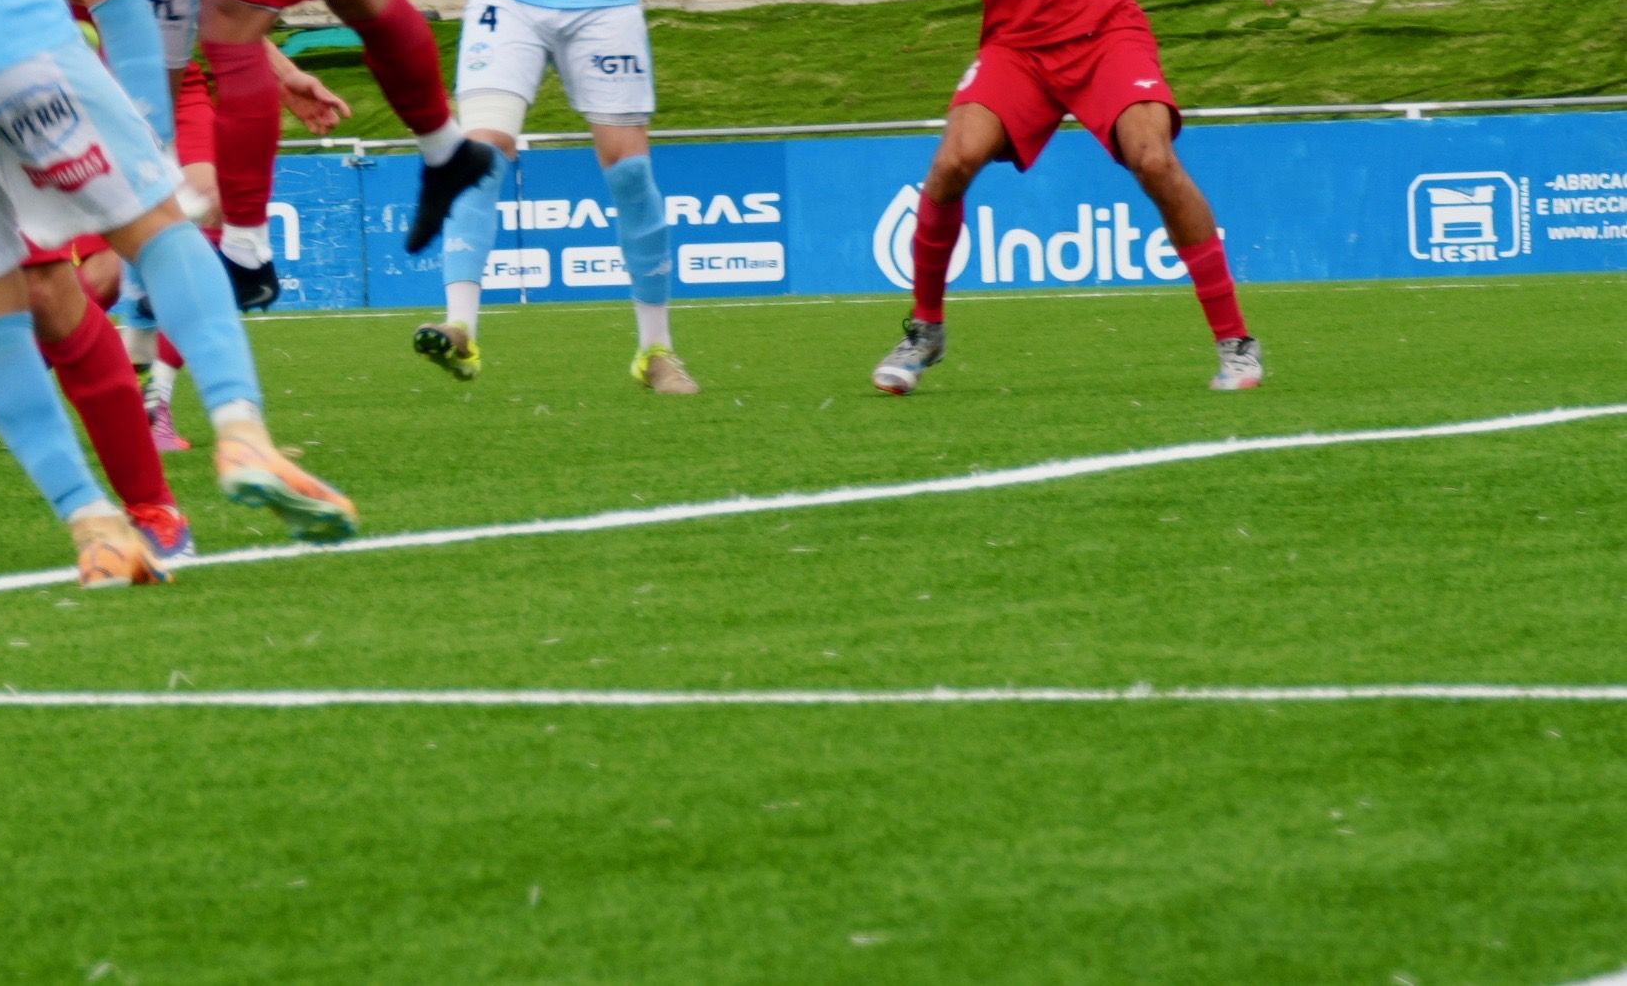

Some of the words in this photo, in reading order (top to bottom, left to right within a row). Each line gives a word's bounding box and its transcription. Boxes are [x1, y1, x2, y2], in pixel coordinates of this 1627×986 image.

[479, 5, 499, 32] 4
[598, 55, 645, 75] GTL
[1536, 198, 1550, 216] E
[1552, 196, 1627, 215] INYECCI
[977, 202, 1225, 284] Indite
[1431, 245, 1499, 263] LESIL
